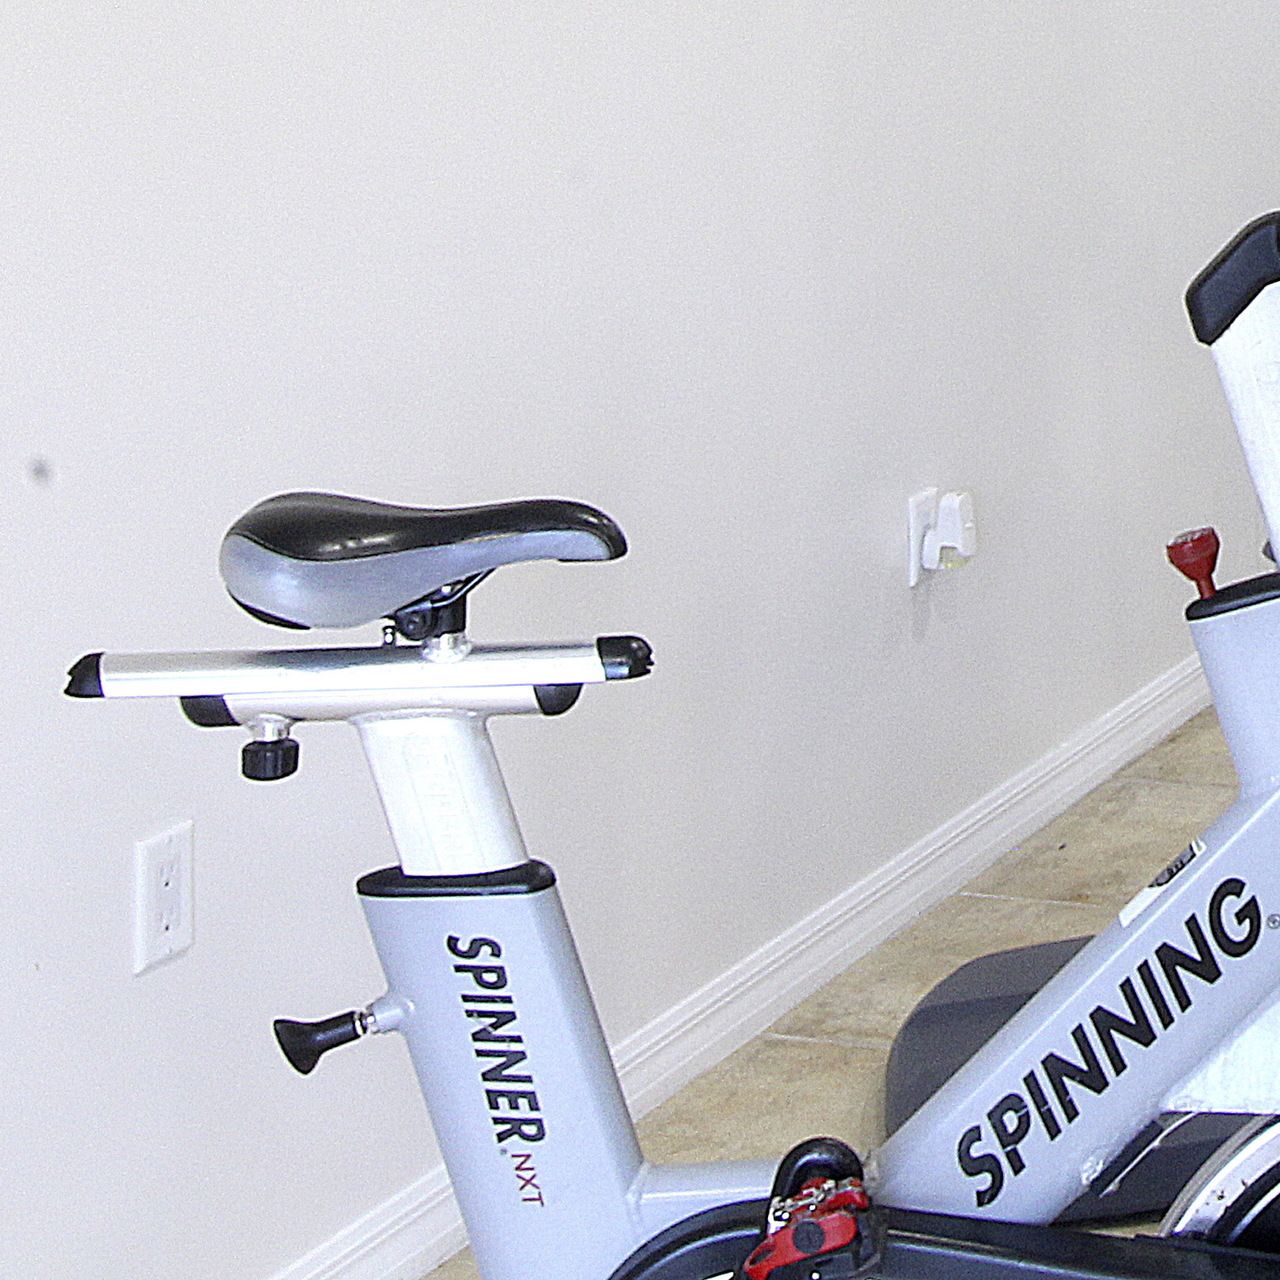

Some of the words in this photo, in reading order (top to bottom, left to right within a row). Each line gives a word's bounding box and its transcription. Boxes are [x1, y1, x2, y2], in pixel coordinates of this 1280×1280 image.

[446, 935, 546, 1144] SPINNER
[511, 1153, 544, 1207] NXT
[957, 877, 1262, 1208] SPINNING
